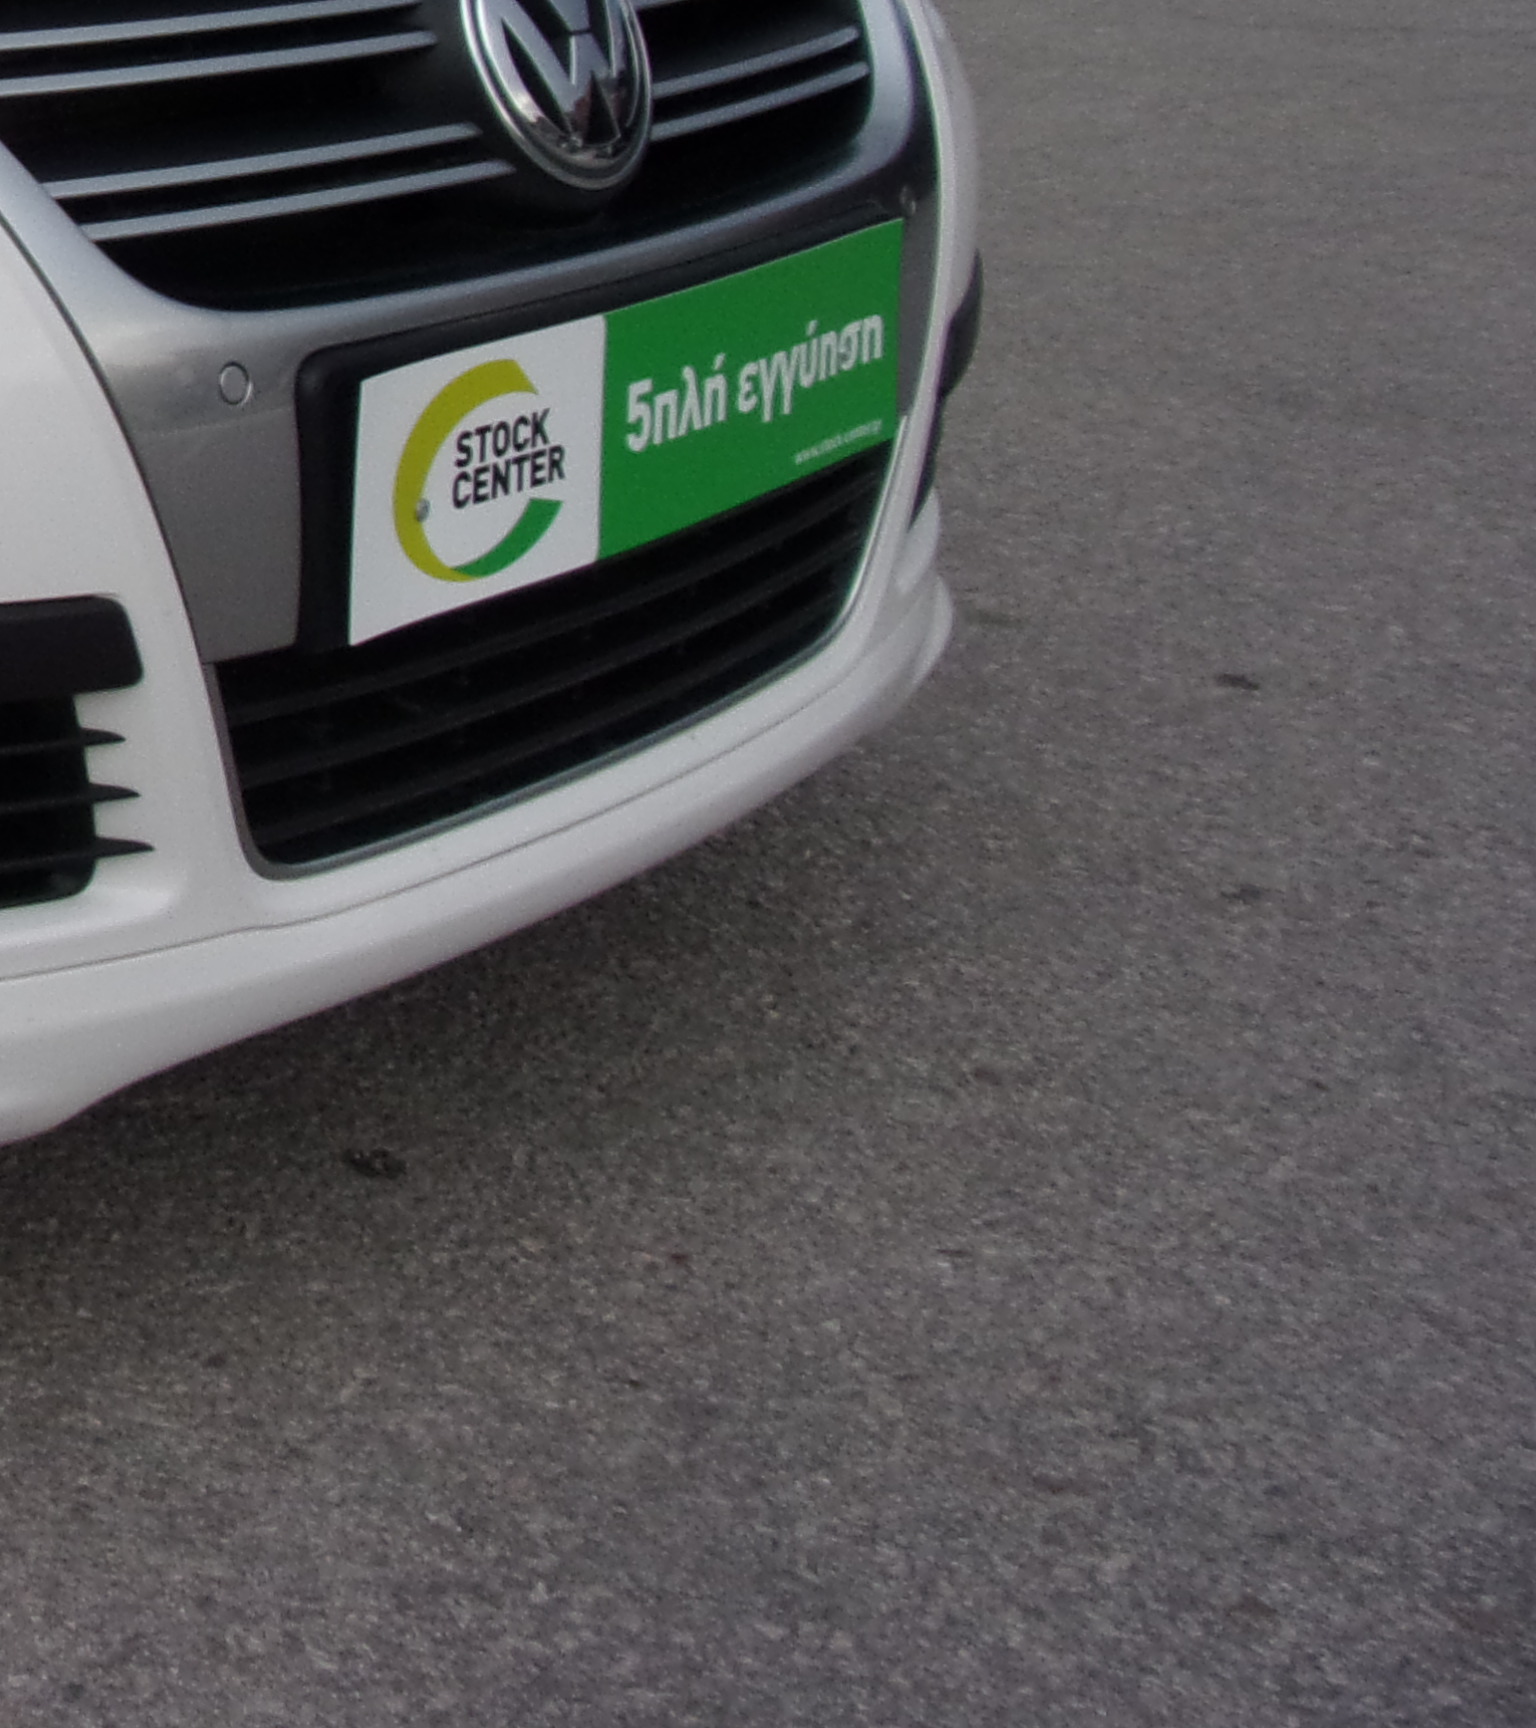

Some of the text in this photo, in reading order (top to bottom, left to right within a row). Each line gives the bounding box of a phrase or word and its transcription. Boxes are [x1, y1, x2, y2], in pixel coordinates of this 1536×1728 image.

[625, 352, 727, 453] 5πλή
[737, 314, 884, 423] εγγύηση
[454, 407, 550, 468] STOCK
[452, 444, 565, 510] CENTER
